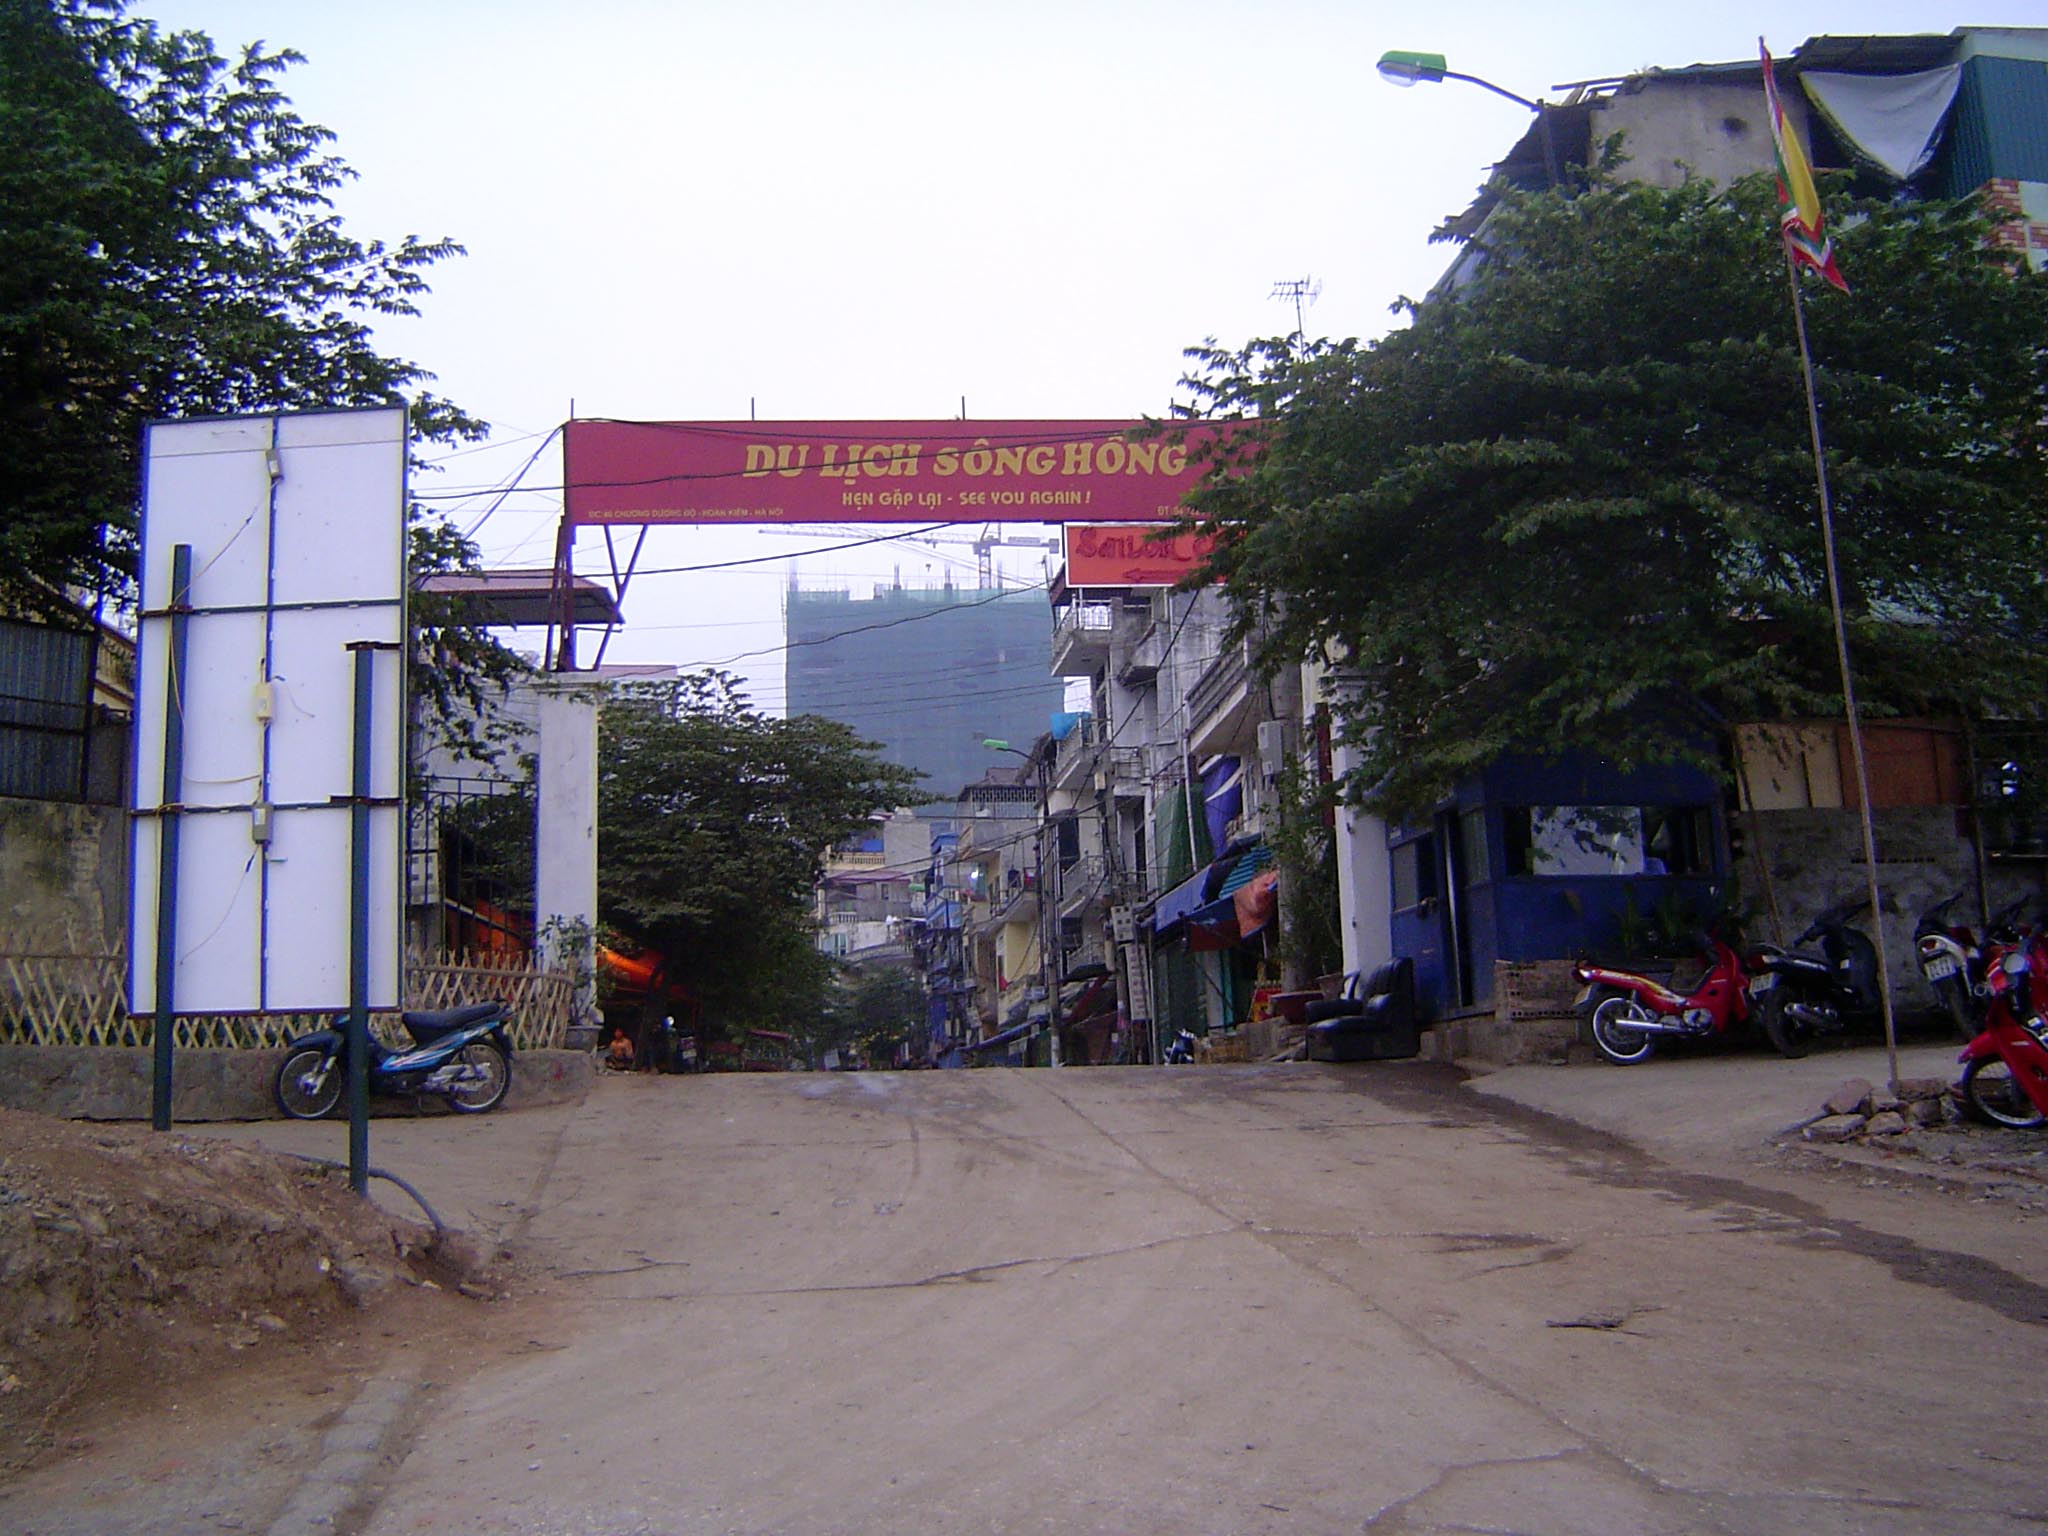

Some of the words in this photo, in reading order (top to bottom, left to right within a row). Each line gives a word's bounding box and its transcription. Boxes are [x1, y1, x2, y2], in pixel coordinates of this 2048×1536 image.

[742, 444, 811, 478] DU
[819, 443, 923, 486] LỊCH
[933, 438, 1058, 477] SÔNG
[842, 491, 874, 512] HẸN
[879, 488, 914, 511] GẶP
[918, 492, 942, 511] LẠI
[959, 491, 986, 506] SEE
[990, 491, 1026, 506] YOU
